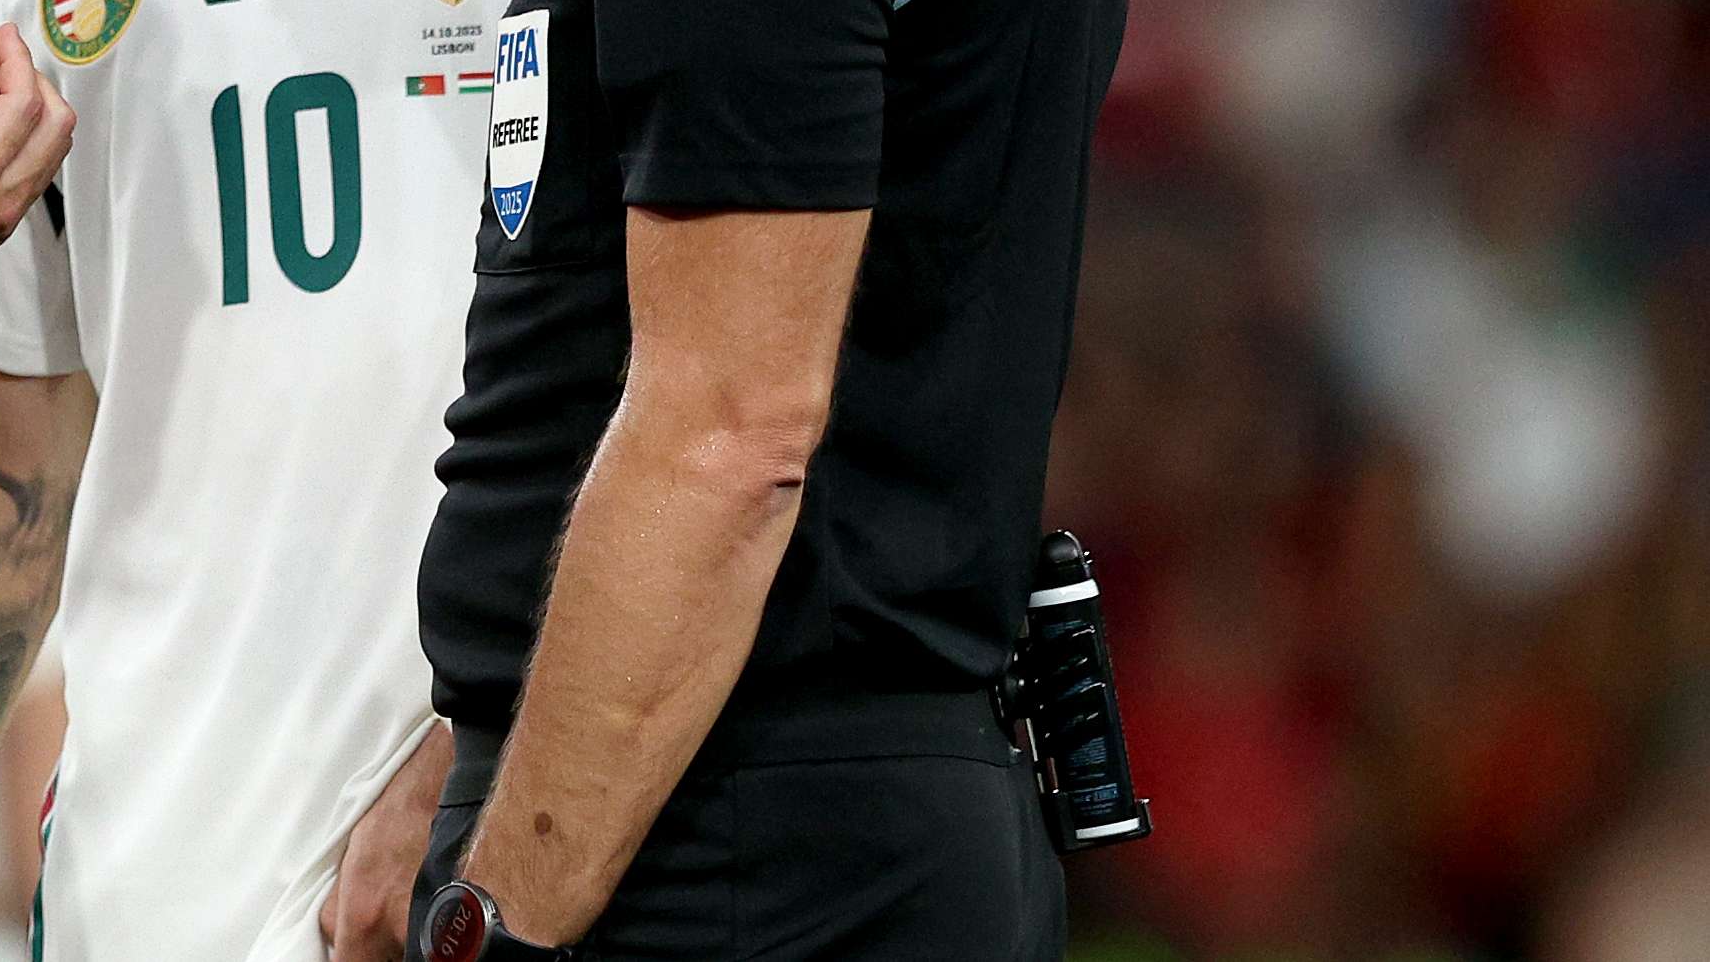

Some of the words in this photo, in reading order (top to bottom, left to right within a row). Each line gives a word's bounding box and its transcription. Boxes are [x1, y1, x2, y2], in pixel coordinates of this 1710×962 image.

[431, 42, 475, 56] LISBON
[496, 28, 540, 85] FIFA
[492, 116, 539, 149] REFEREE
[211, 72, 362, 307] 10
[500, 190, 523, 216] 2025
